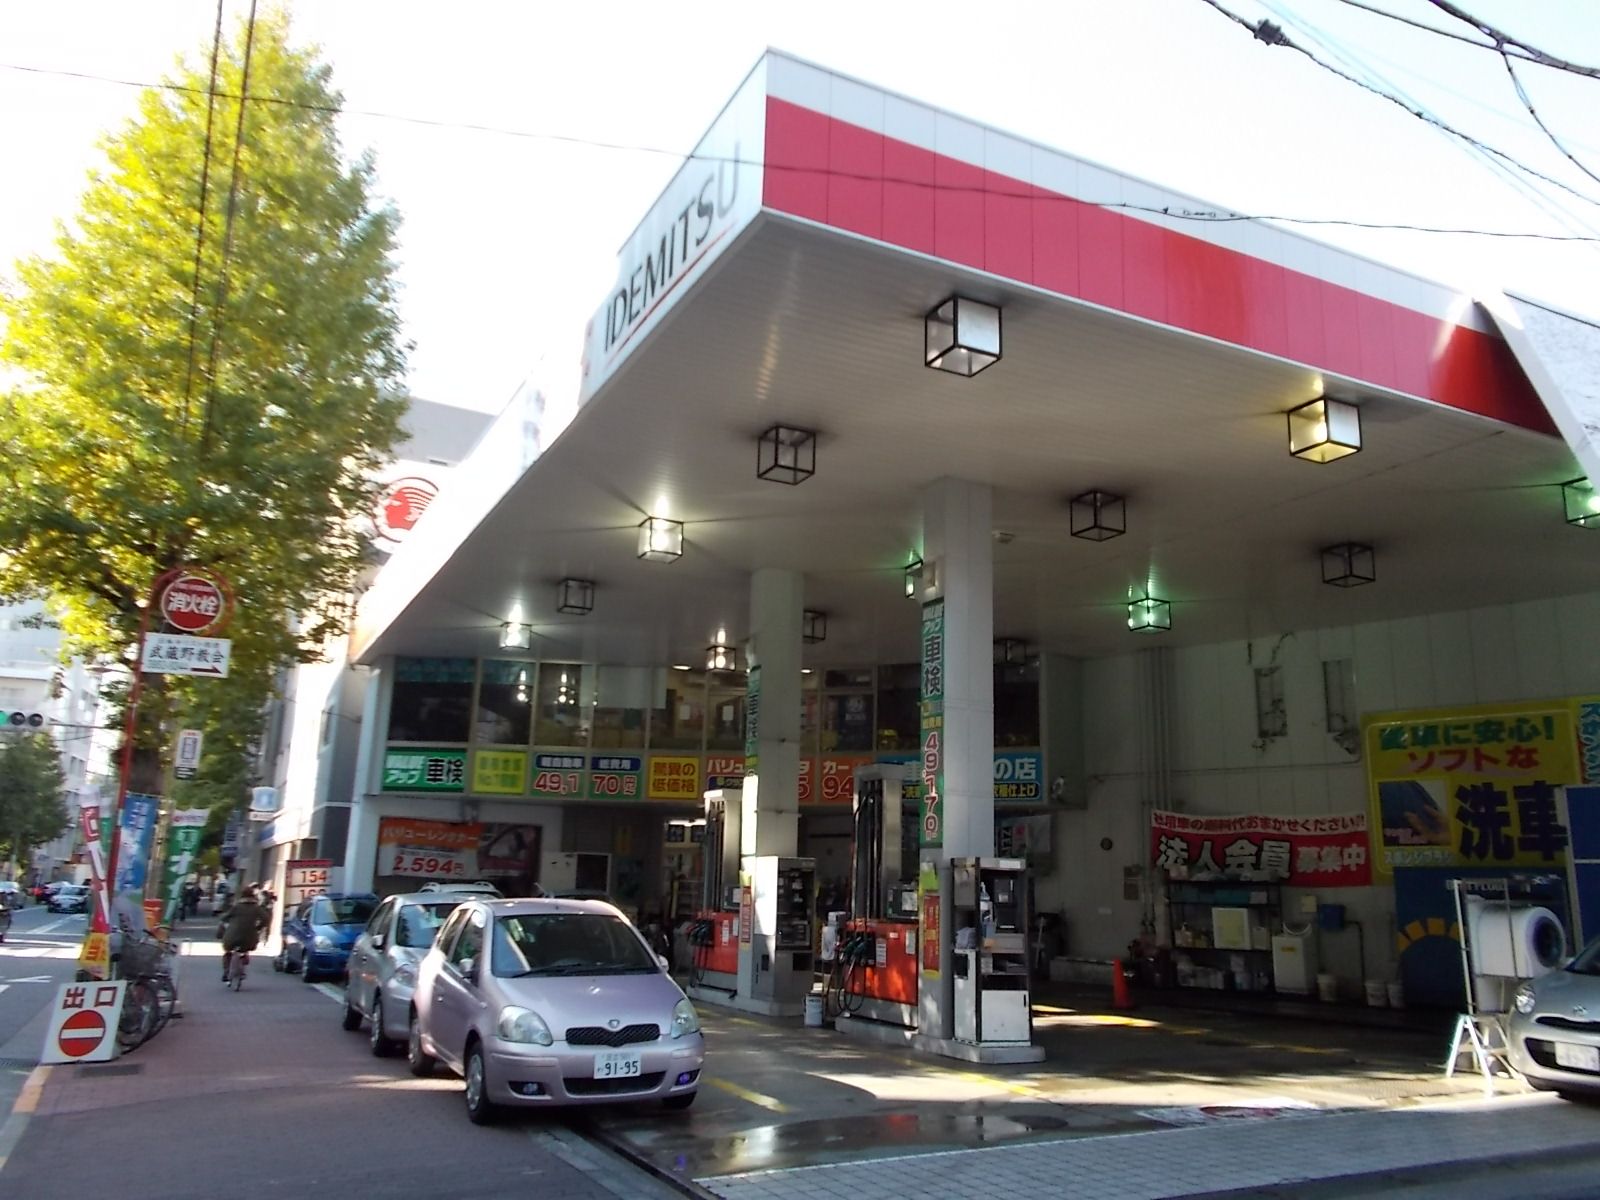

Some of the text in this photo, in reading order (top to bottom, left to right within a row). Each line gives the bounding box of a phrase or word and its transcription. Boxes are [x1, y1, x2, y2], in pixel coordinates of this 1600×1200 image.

[605, 140, 741, 352] IDEMITSU
[168, 591, 218, 616] 消火栓
[149, 646, 225, 663] 武蔵野教会
[922, 634, 942, 698] 車検
[1380, 716, 1555, 750] 愛車に安心!
[425, 757, 464, 784] 車検
[993, 758, 1036, 781] の店
[1408, 745, 1540, 773] ソフトな
[653, 778, 695, 793] 低価格
[1455, 780, 1569, 861] 洗車
[1156, 834, 1366, 879] 法人会員 募集中
[301, 870, 327, 883] 154
[62, 986, 118, 1009] 出口
[604, 1060, 639, 1076] 91-95
